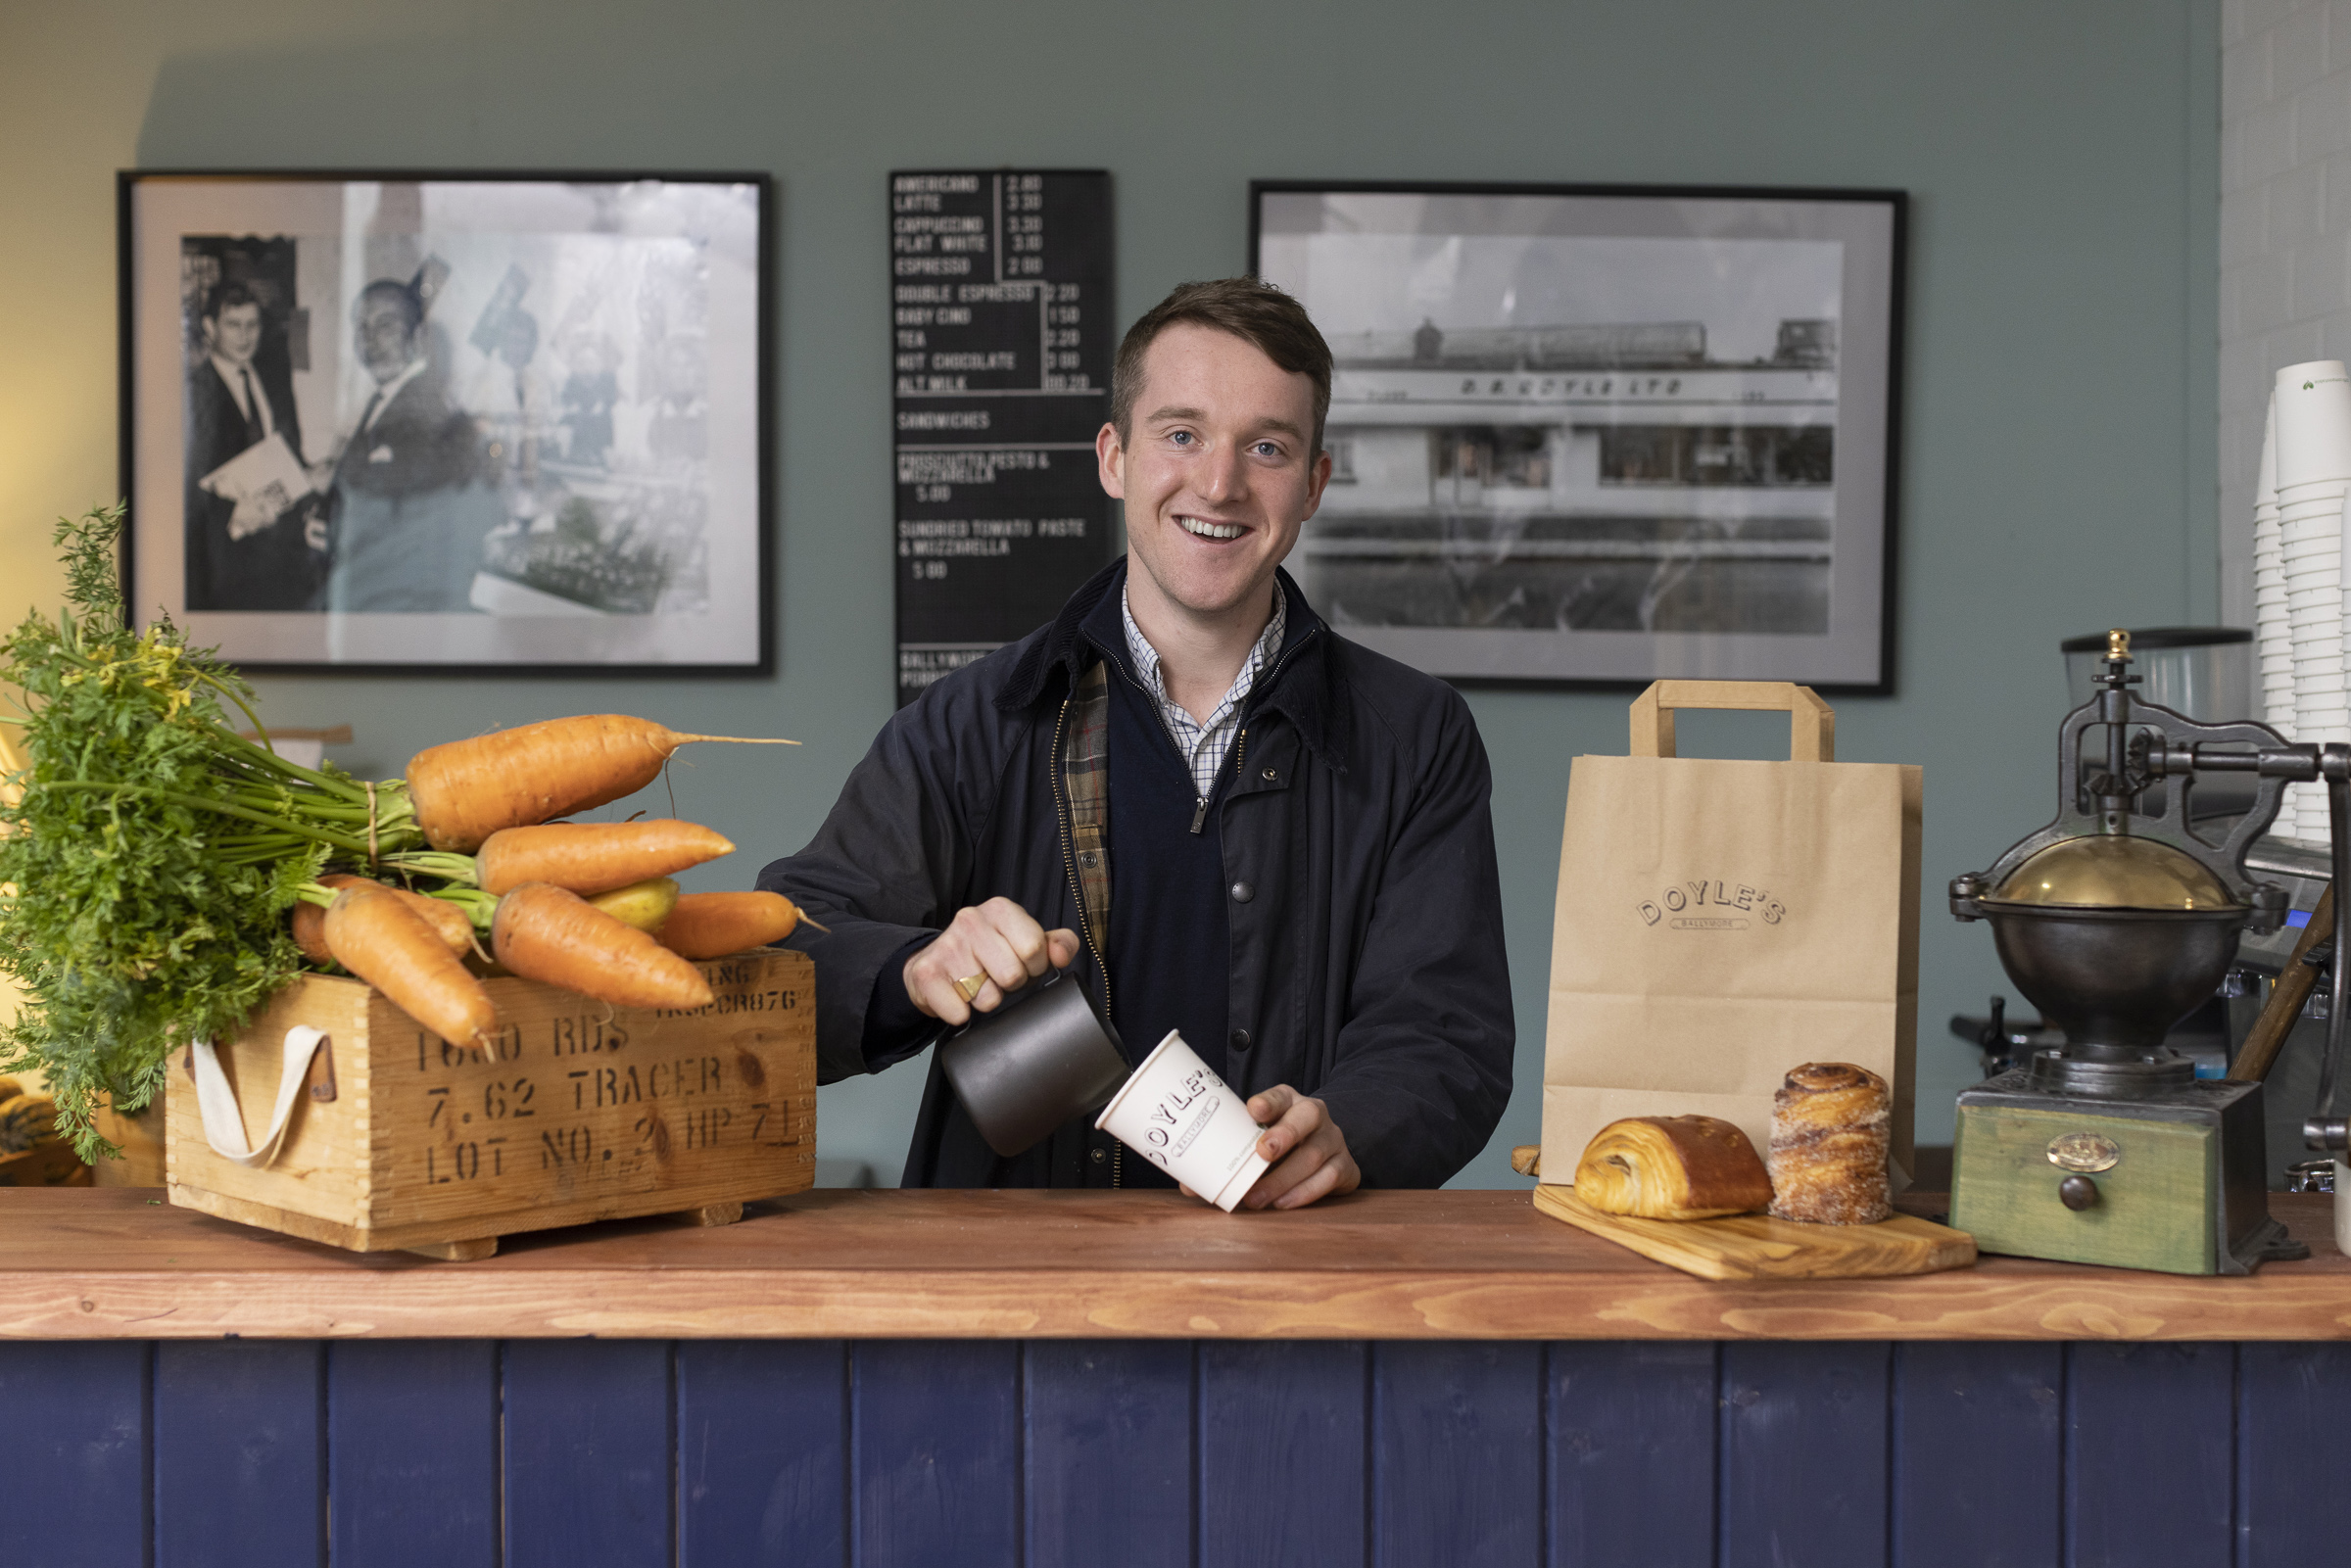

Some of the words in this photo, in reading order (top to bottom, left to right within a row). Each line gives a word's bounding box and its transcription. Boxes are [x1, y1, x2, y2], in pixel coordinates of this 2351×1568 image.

[894, 175, 979, 193] AMERICANO
[894, 194, 942, 212] LATTE
[894, 216, 984, 234] CAPPUCCINO
[894, 235, 934, 252] FLAT
[940, 234, 987, 252] WHITE
[894, 257, 971, 275] ESPRESSO
[895, 284, 951, 303] DOUBLE
[958, 284, 1034, 302] ESPRESSO
[895, 308, 934, 325] BABY
[936, 308, 972, 325] CINO
[896, 330, 927, 348] TEA
[896, 352, 926, 370] HOT
[933, 352, 1016, 370] CHOCOLATE
[928, 374, 968, 391] MILK
[896, 411, 990, 430] SANDWICHES
[898, 520, 970, 538] SUNDRIED
[972, 519, 1032, 537] TOMATO
[1037, 518, 1086, 537] PASTE
[898, 539, 911, 556] &
[912, 538, 1010, 556] MOZZARELLA
[1636, 879, 1786, 927] DOYLE'S
[427, 1077, 535, 1128] 7.62
[568, 1057, 721, 1111] TRACER
[1177, 1106, 1212, 1151] BALLYMORE
[427, 1137, 506, 1185] LOT
